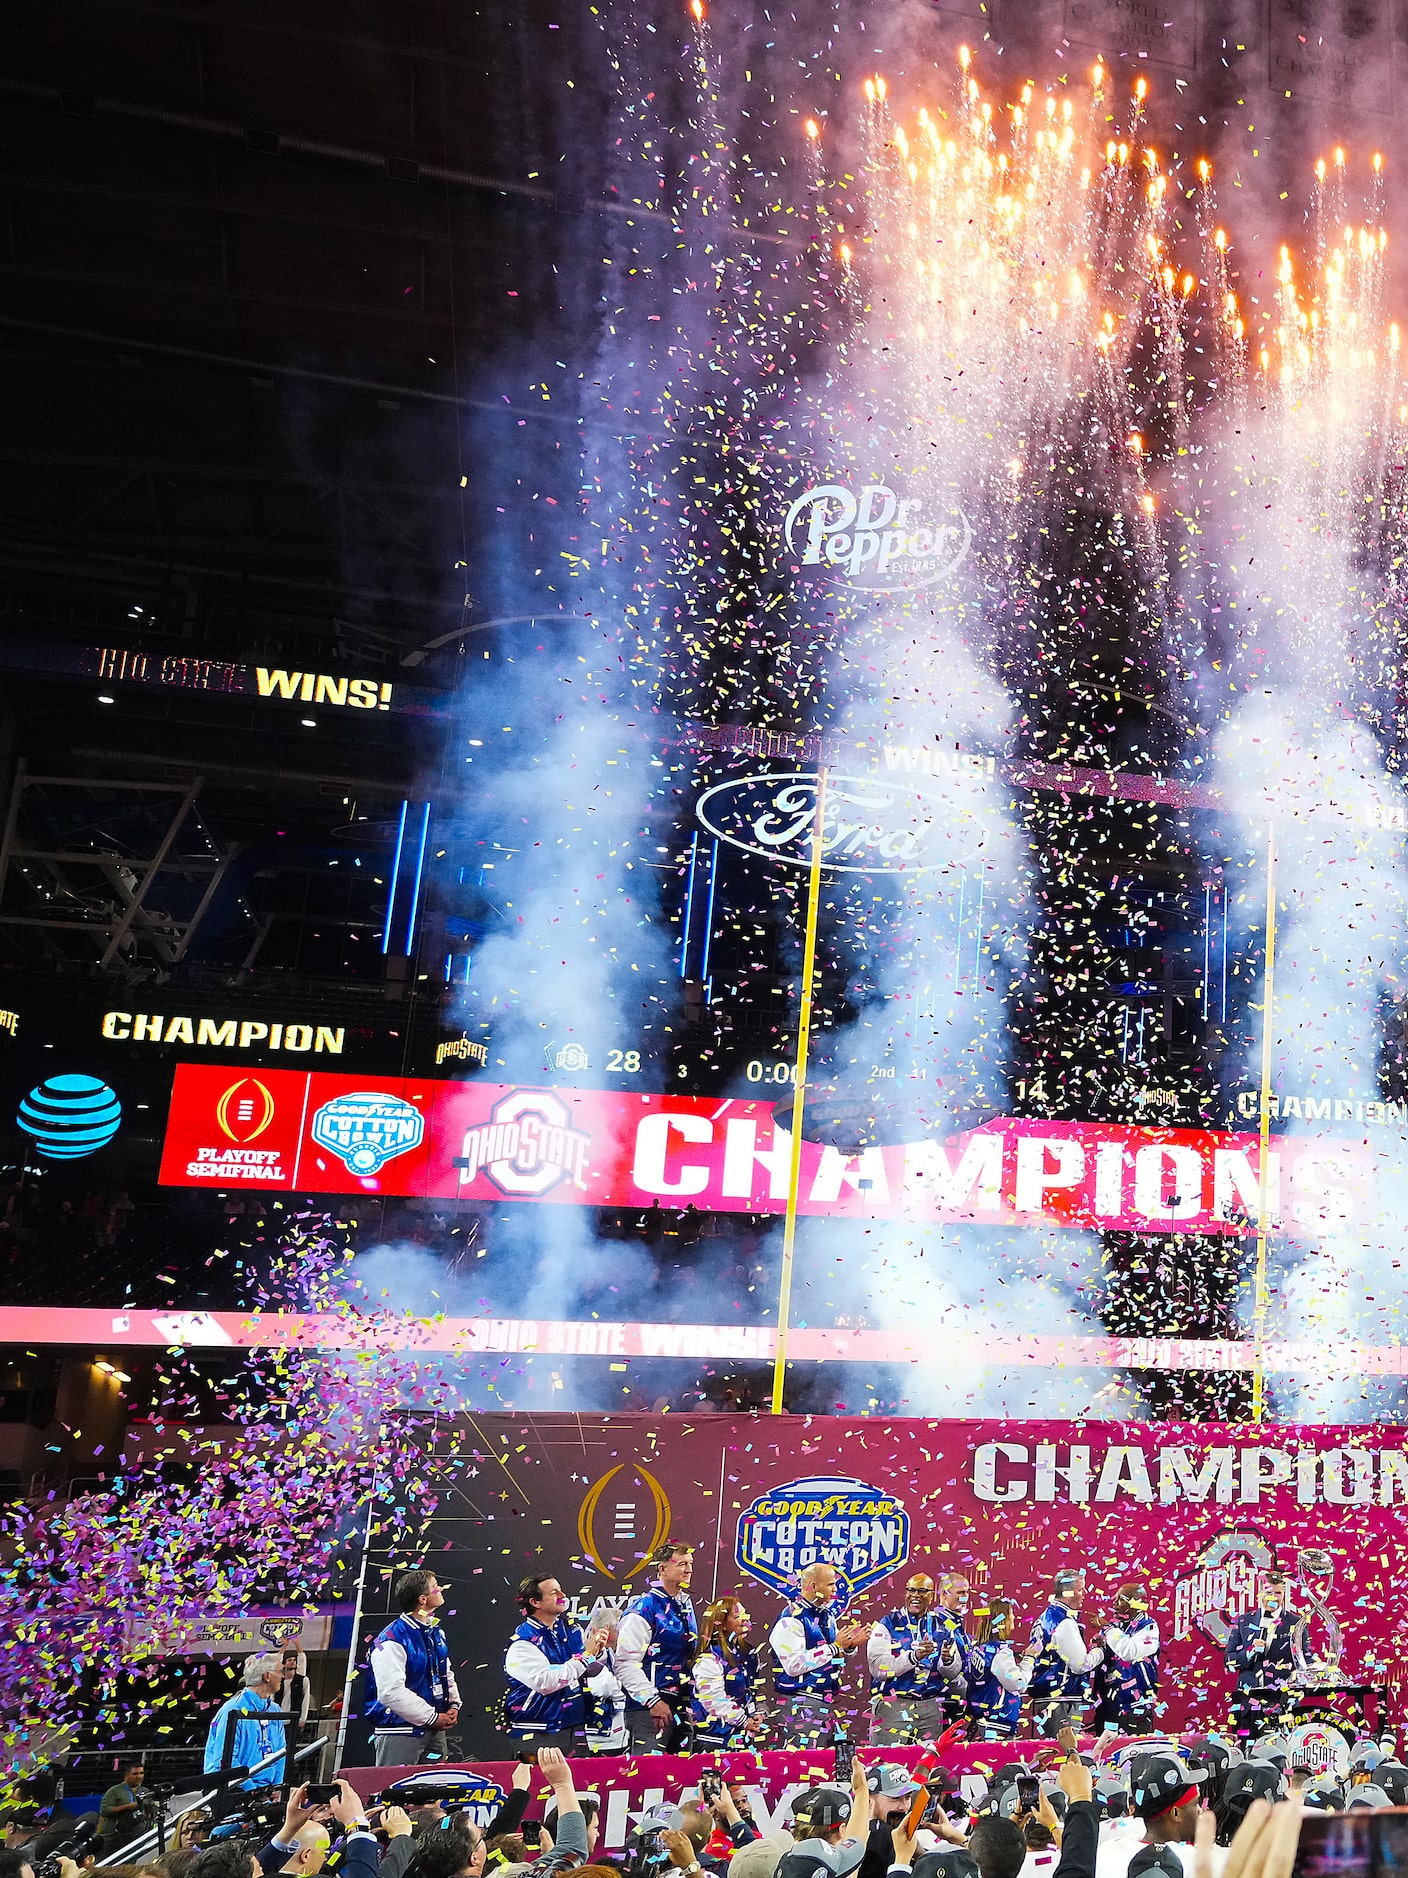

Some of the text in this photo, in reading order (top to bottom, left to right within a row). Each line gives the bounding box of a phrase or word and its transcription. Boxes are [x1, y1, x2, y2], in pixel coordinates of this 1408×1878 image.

[855, 485, 922, 530] Dr
[786, 485, 960, 576] Pepper
[255, 667, 393, 711] WINS!
[882, 744, 996, 783] WINS!
[753, 785, 935, 860] Ford
[102, 1011, 346, 1054] CHAMPION
[605, 1049, 642, 1073] 28
[678, 1064, 688, 1078] 3
[871, 1064, 896, 1079] 2nd
[1015, 1079, 1045, 1101] 14
[327, 1104, 414, 1118] GOODYEAR
[322, 1115, 415, 1143] COTTON
[337, 1130, 396, 1149] BOWL
[197, 1148, 281, 1165] PLAYOFF
[632, 1112, 1355, 1226] CHAMPIONS
[186, 1163, 285, 1181] SEMIFINAL
[469, 1319, 772, 1359] OHIO STATE WINS!
[757, 1497, 895, 1519] GOODYEAR
[751, 1520, 896, 1564] COTTON
[777, 1546, 869, 1574] BOWL
[1228, 1558, 1299, 1620] STE
